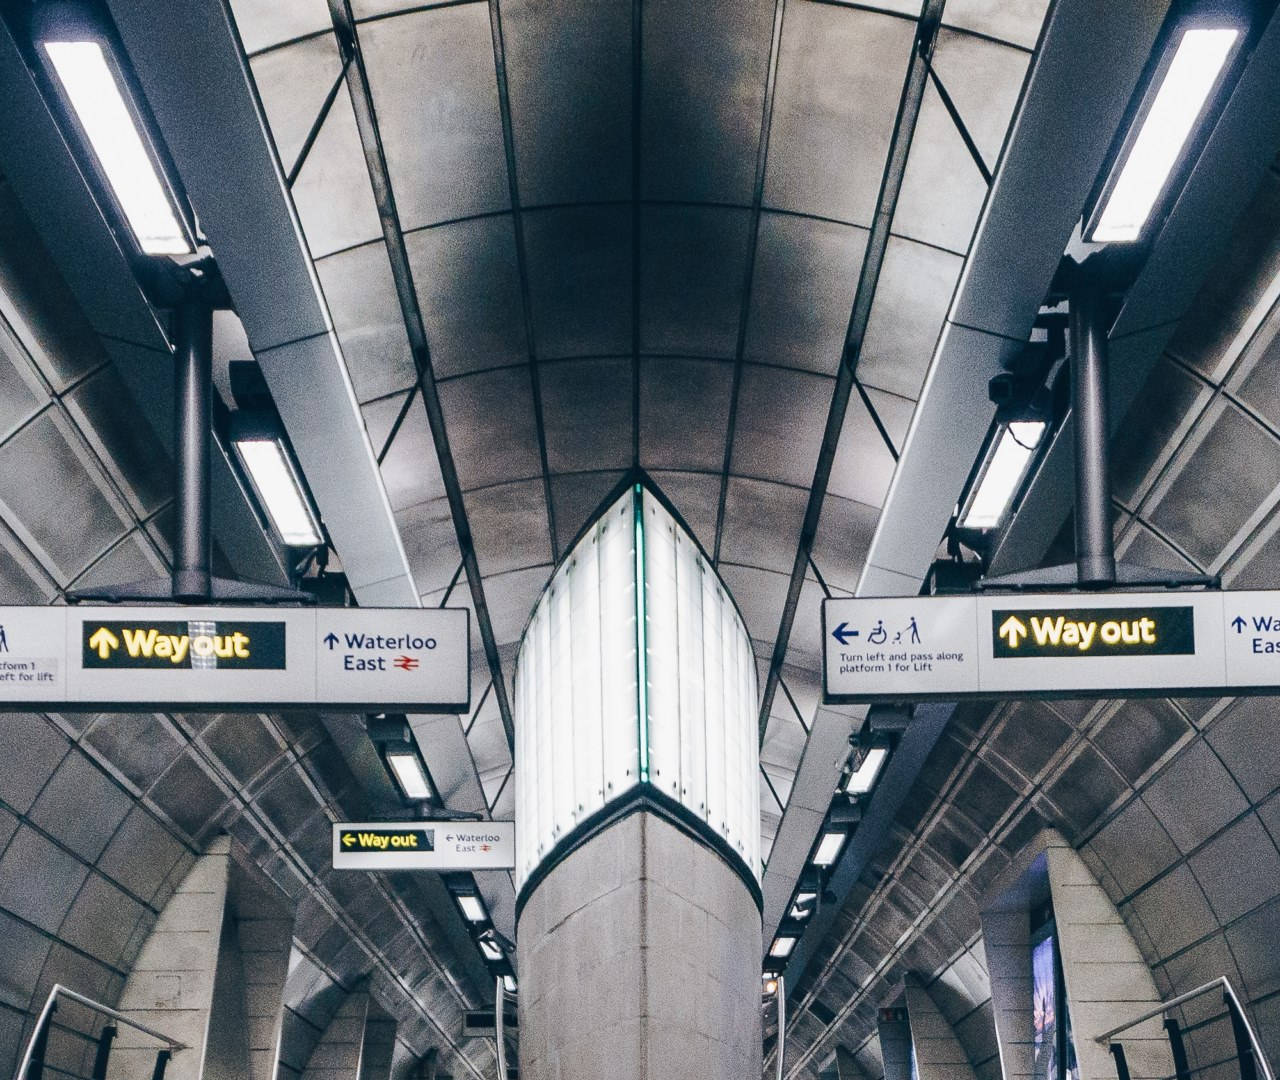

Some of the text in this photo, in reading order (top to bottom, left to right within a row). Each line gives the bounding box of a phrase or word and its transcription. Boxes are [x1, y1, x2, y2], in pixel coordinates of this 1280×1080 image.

[1030, 616, 1156, 650] Way out
[122, 629, 251, 664] Way out
[344, 633, 438, 650] Waterloo
[840, 652, 964, 662] Turn left and pass along
[31, 662, 36, 670] 1
[344, 655, 386, 671] East
[840, 664, 884, 674] platform
[895, 663, 910, 672] for
[913, 663, 933, 672] Lift
[19, 673, 34, 681] for
[357, 833, 418, 849] Way out
[456, 833, 500, 842] Waterloo
[456, 844, 476, 852] East
